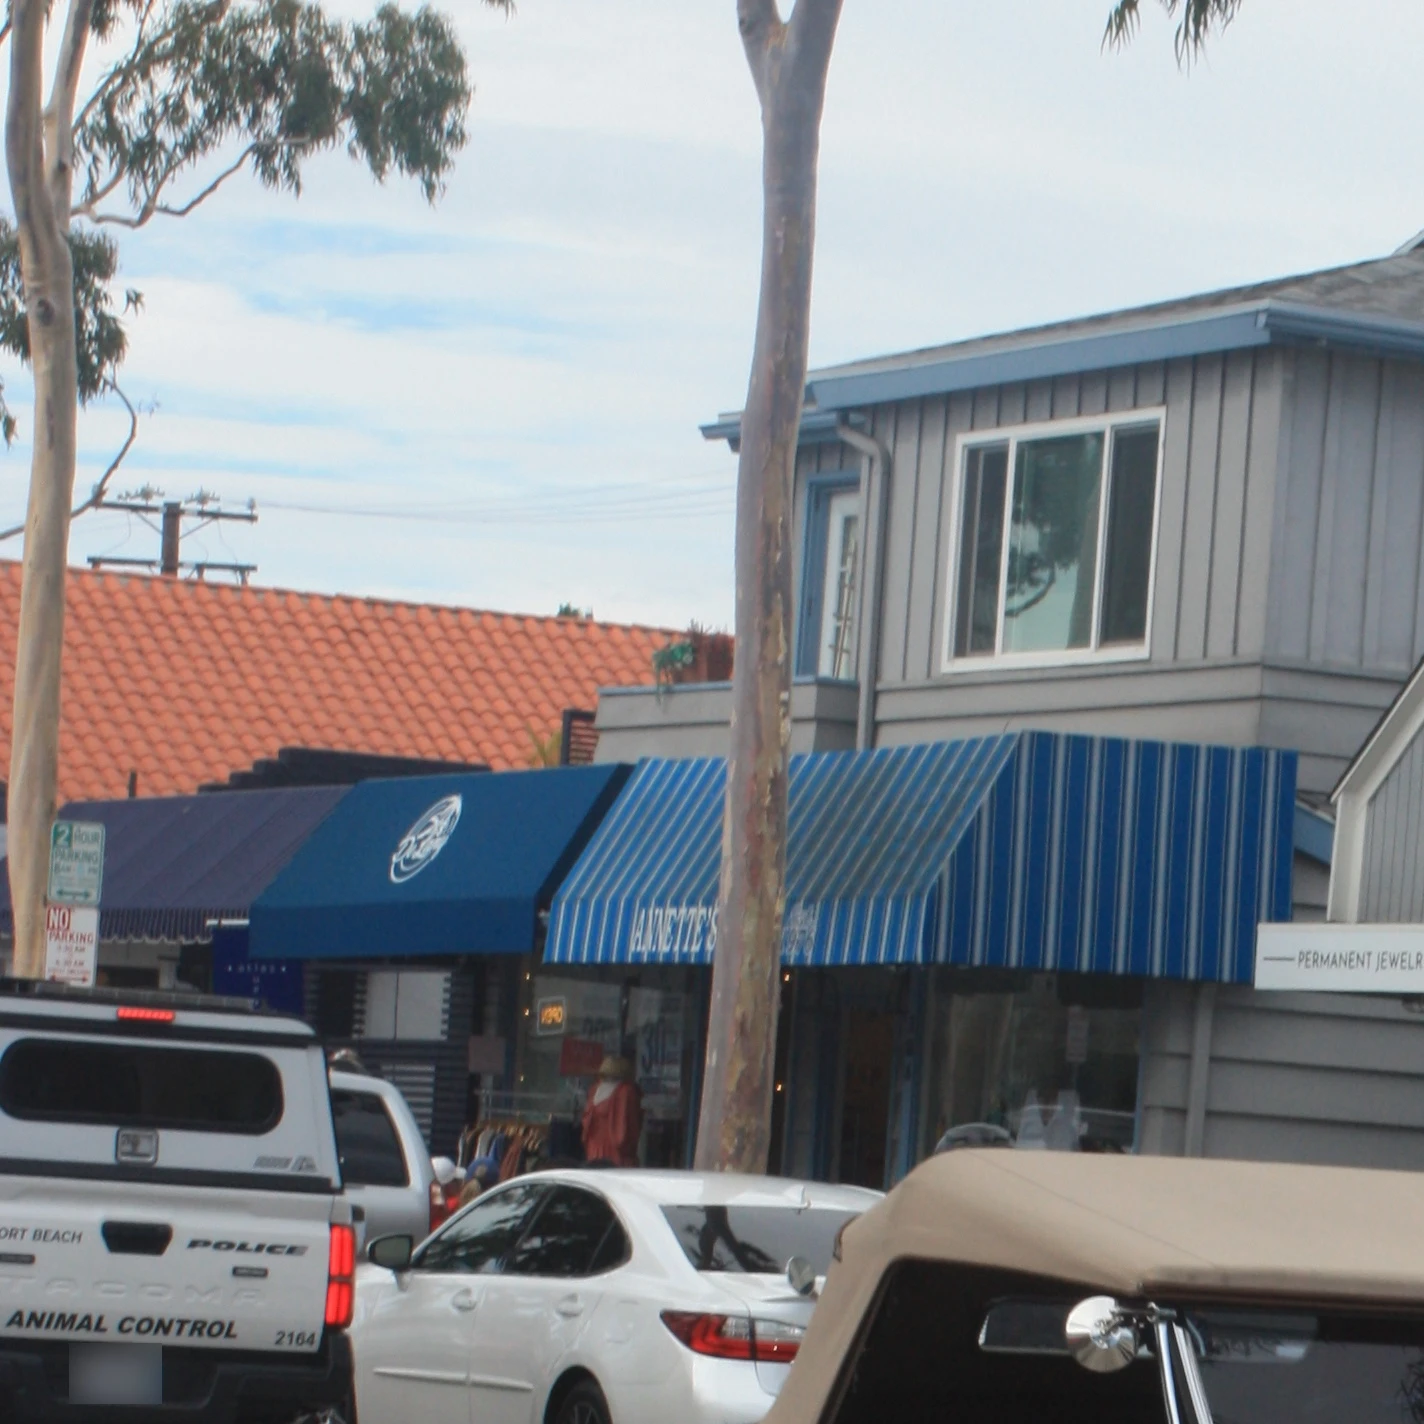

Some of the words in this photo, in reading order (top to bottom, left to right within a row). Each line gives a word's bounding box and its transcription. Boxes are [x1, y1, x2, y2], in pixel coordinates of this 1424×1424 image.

[56, 826, 70, 847] 2
[54, 850, 99, 864] PARKING
[48, 908, 70, 930] NO
[49, 932, 94, 944] PARKING
[629, 907, 720, 954] ANNETTE'S
[1298, 951, 1373, 970] PERMANENT
[32, 1228, 83, 1244] BEACH
[187, 1239, 309, 1256] POLICE
[6, 1310, 107, 1333] ANIMAL
[117, 1316, 238, 1339] CONTROL
[274, 1330, 316, 1347] 2164
